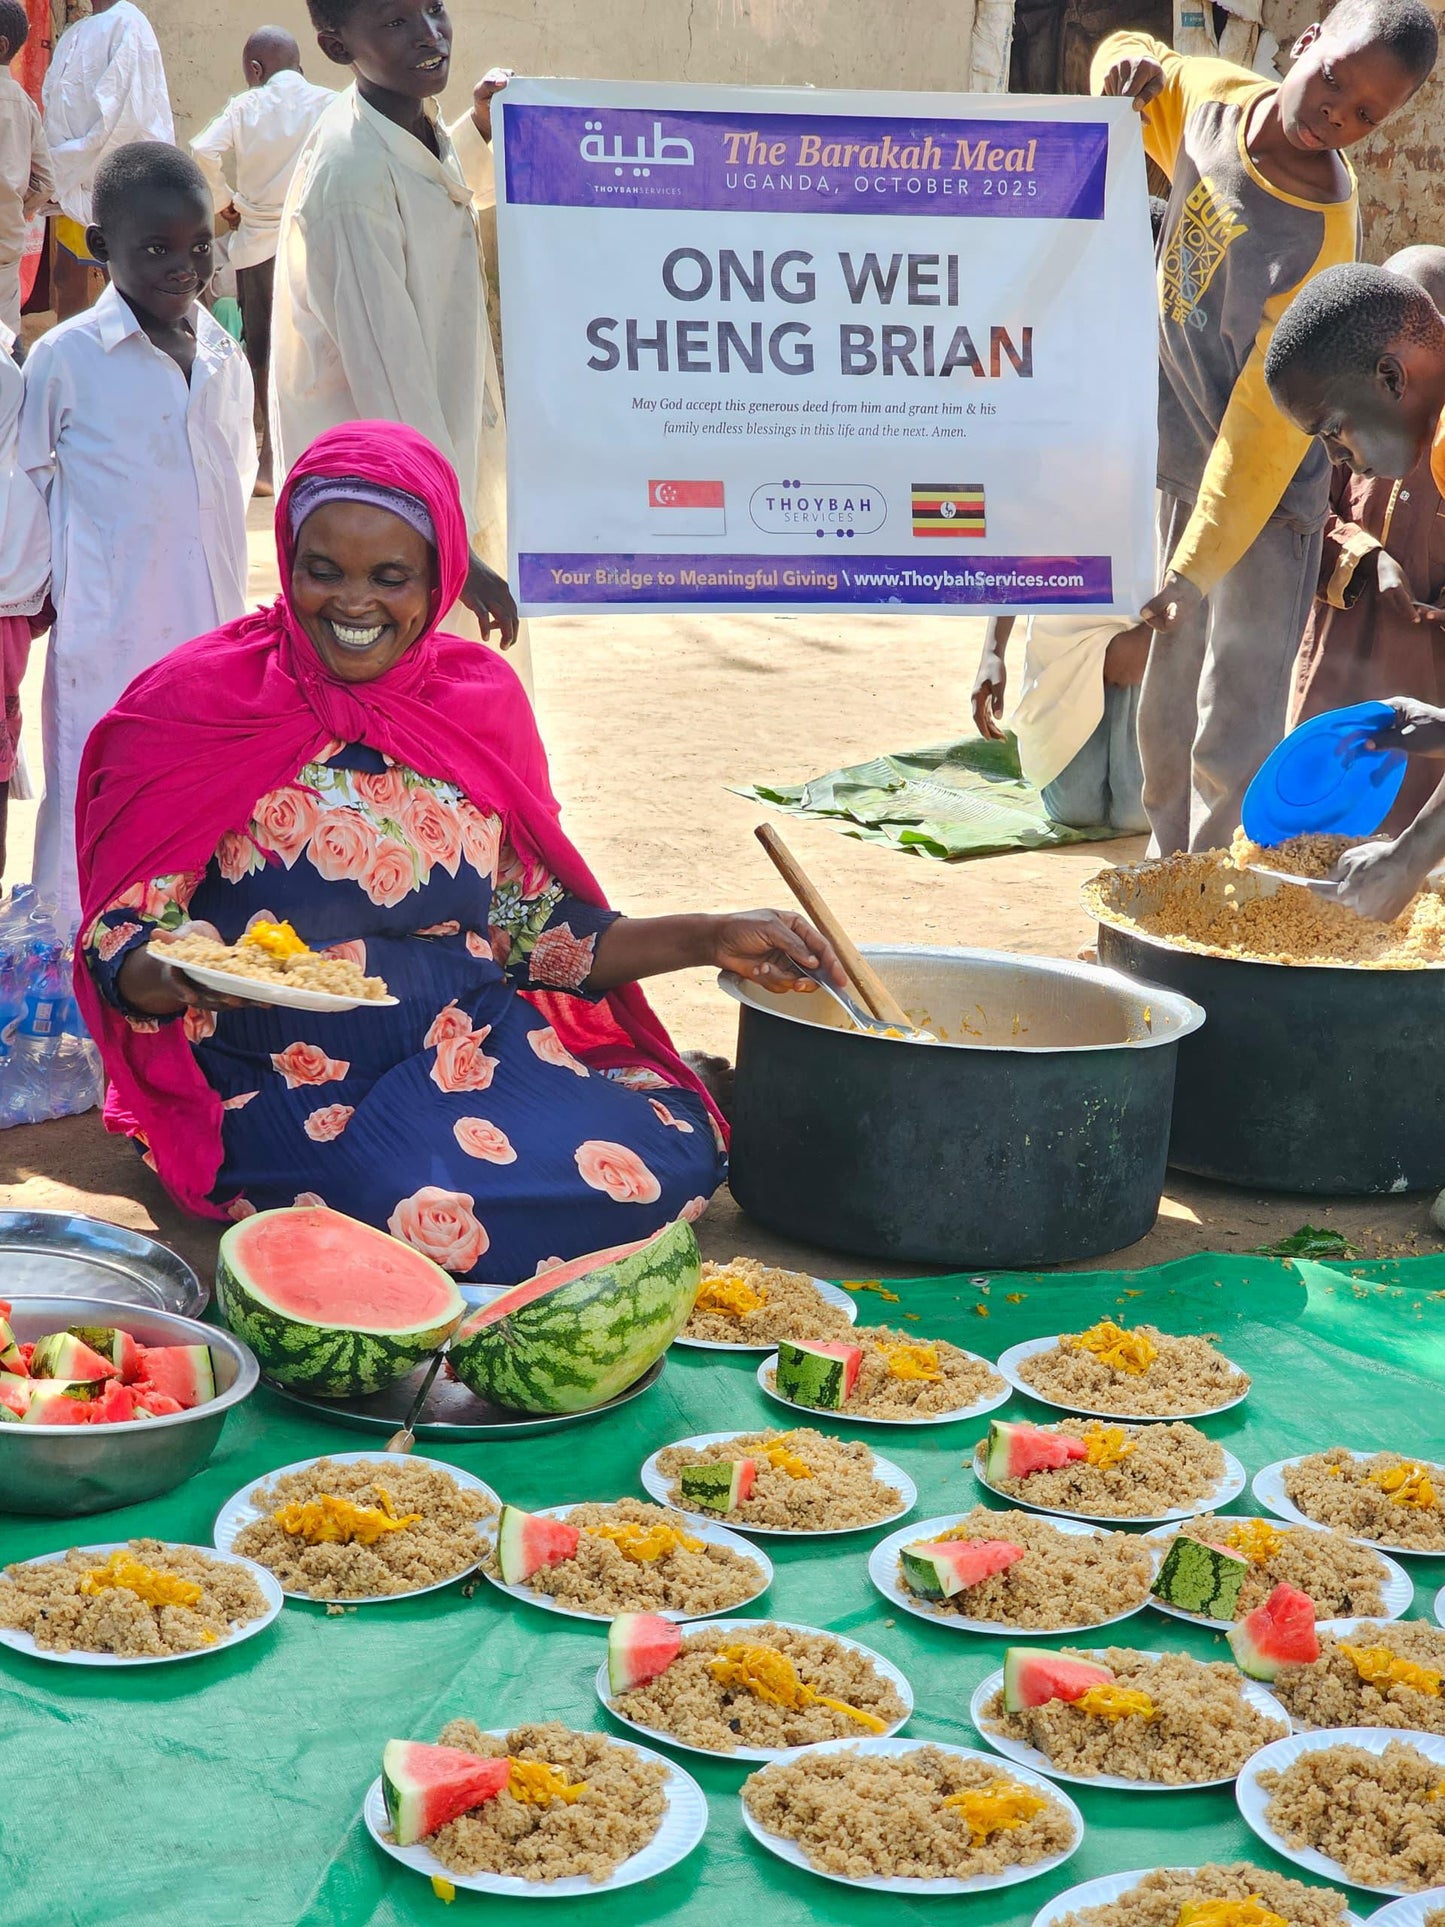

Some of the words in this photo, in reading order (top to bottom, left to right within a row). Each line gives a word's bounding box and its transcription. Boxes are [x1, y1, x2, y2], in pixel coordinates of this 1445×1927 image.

[580, 121, 695, 177] طيبة
[722, 131, 787, 167] The
[795, 135, 942, 171] Barakah
[951, 138, 1038, 174] Meal
[726, 173, 840, 195] UGANDA,
[854, 176, 970, 196] OCTOBER
[983, 179, 1038, 197] 2025
[661, 247, 817, 304] ONG
[838, 252, 960, 307] WEI
[586, 316, 815, 376] SHENG
[839, 323, 1034, 379] BRIAN
[632, 397, 657, 412] May
[660, 398, 683, 410] God
[686, 400, 722, 413] accept
[725, 400, 746, 411] this
[749, 402, 799, 414] generous
[802, 401, 828, 413] deed
[831, 401, 857, 415] from
[861, 402, 881, 413] him
[885, 402, 906, 414] and
[909, 404, 938, 416] grant
[942, 403, 962, 415] him
[966, 405, 976, 415] &
[980, 404, 997, 415] his
[664, 421, 699, 437] family
[702, 422, 743, 434] endless
[746, 422, 797, 437] blessings
[800, 424, 811, 435] in
[814, 424, 834, 436] this
[838, 424, 855, 437] life
[858, 425, 879, 436] and
[882, 425, 899, 437] the
[903, 427, 928, 437] next.
[931, 426, 967, 438] Amen.
[766, 497, 871, 512] THOYBAH
[784, 512, 854, 522] SERVICES
[551, 569, 591, 585] Your
[595, 569, 652, 589] Bridge
[657, 571, 675, 585] to
[680, 569, 777, 589] Meaningful
[782, 570, 838, 590] Giving
[854, 571, 1084, 590] www.ThoybahServices.com
